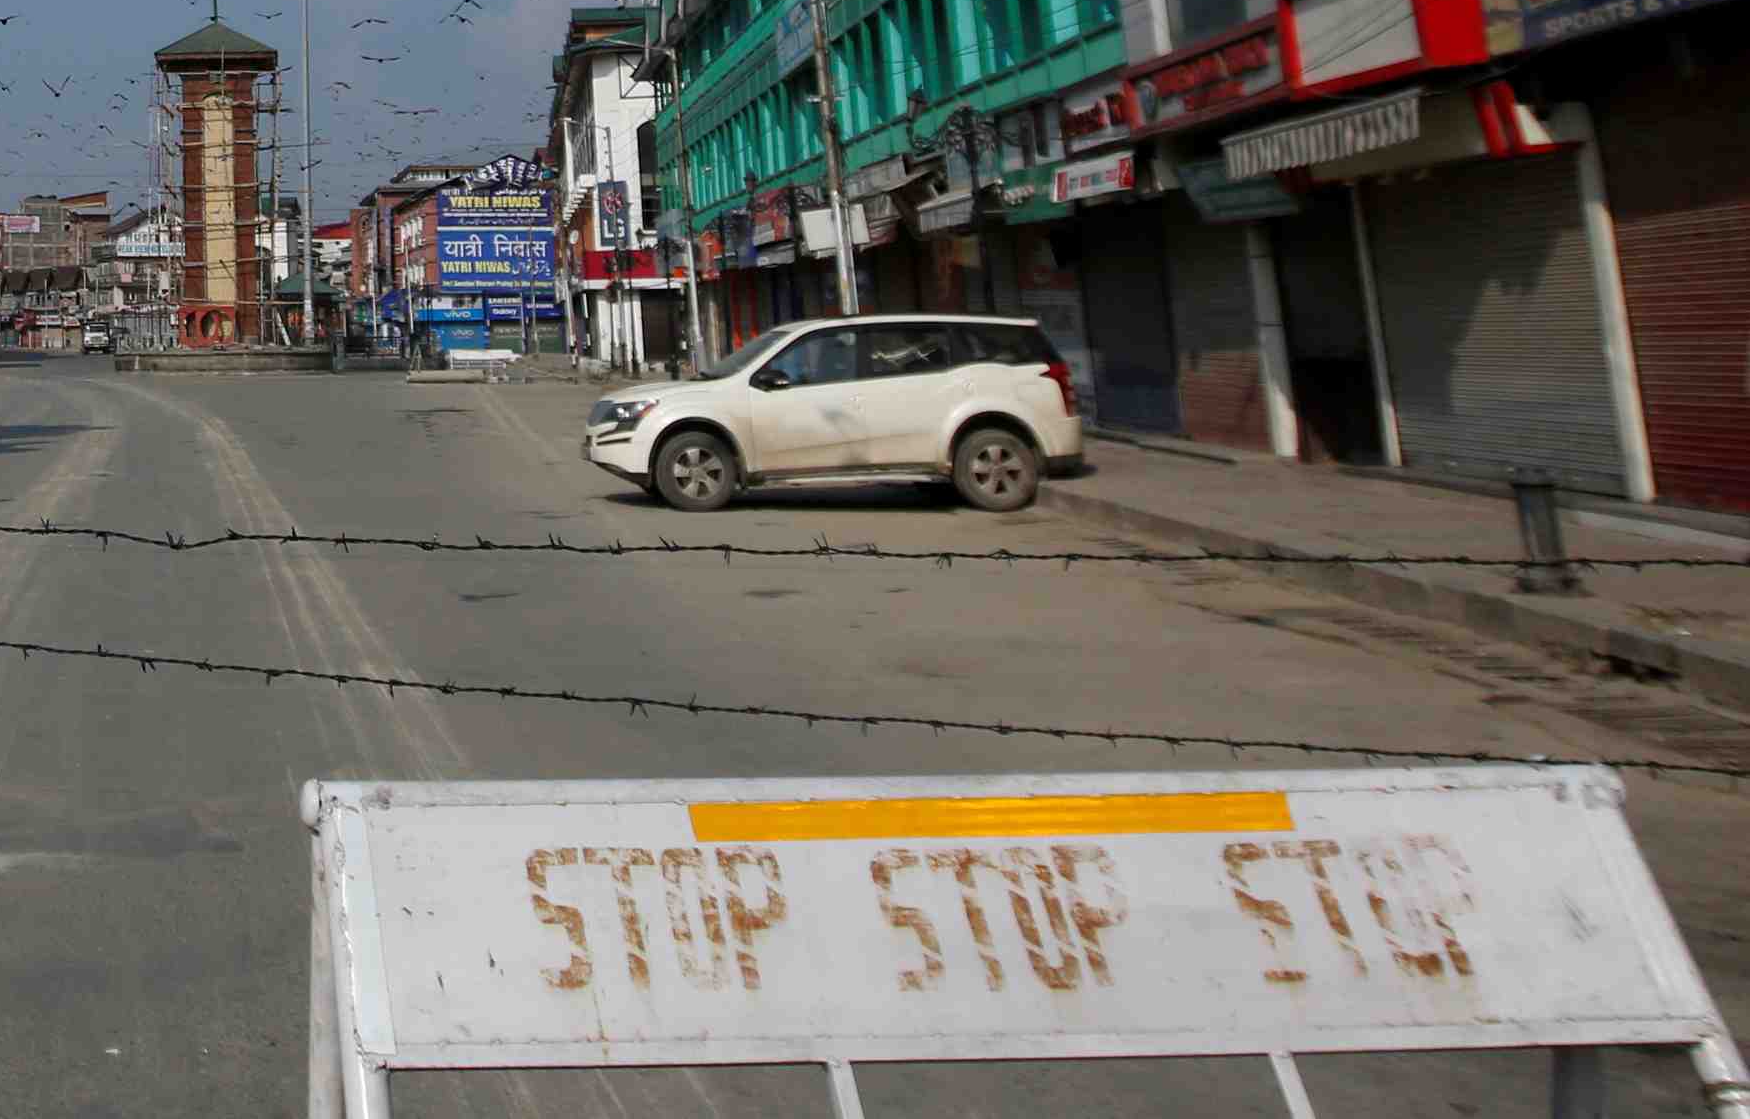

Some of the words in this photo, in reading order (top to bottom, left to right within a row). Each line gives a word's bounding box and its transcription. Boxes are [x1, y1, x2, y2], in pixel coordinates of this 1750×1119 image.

[450, 195, 490, 208] YATRI
[492, 195, 541, 208] NIWAS
[443, 234, 484, 258] यात्री
[442, 262, 472, 274] YATRI
[475, 262, 511, 274] NIWAS
[525, 844, 787, 990] STOP
[870, 843, 1130, 991] STOP
